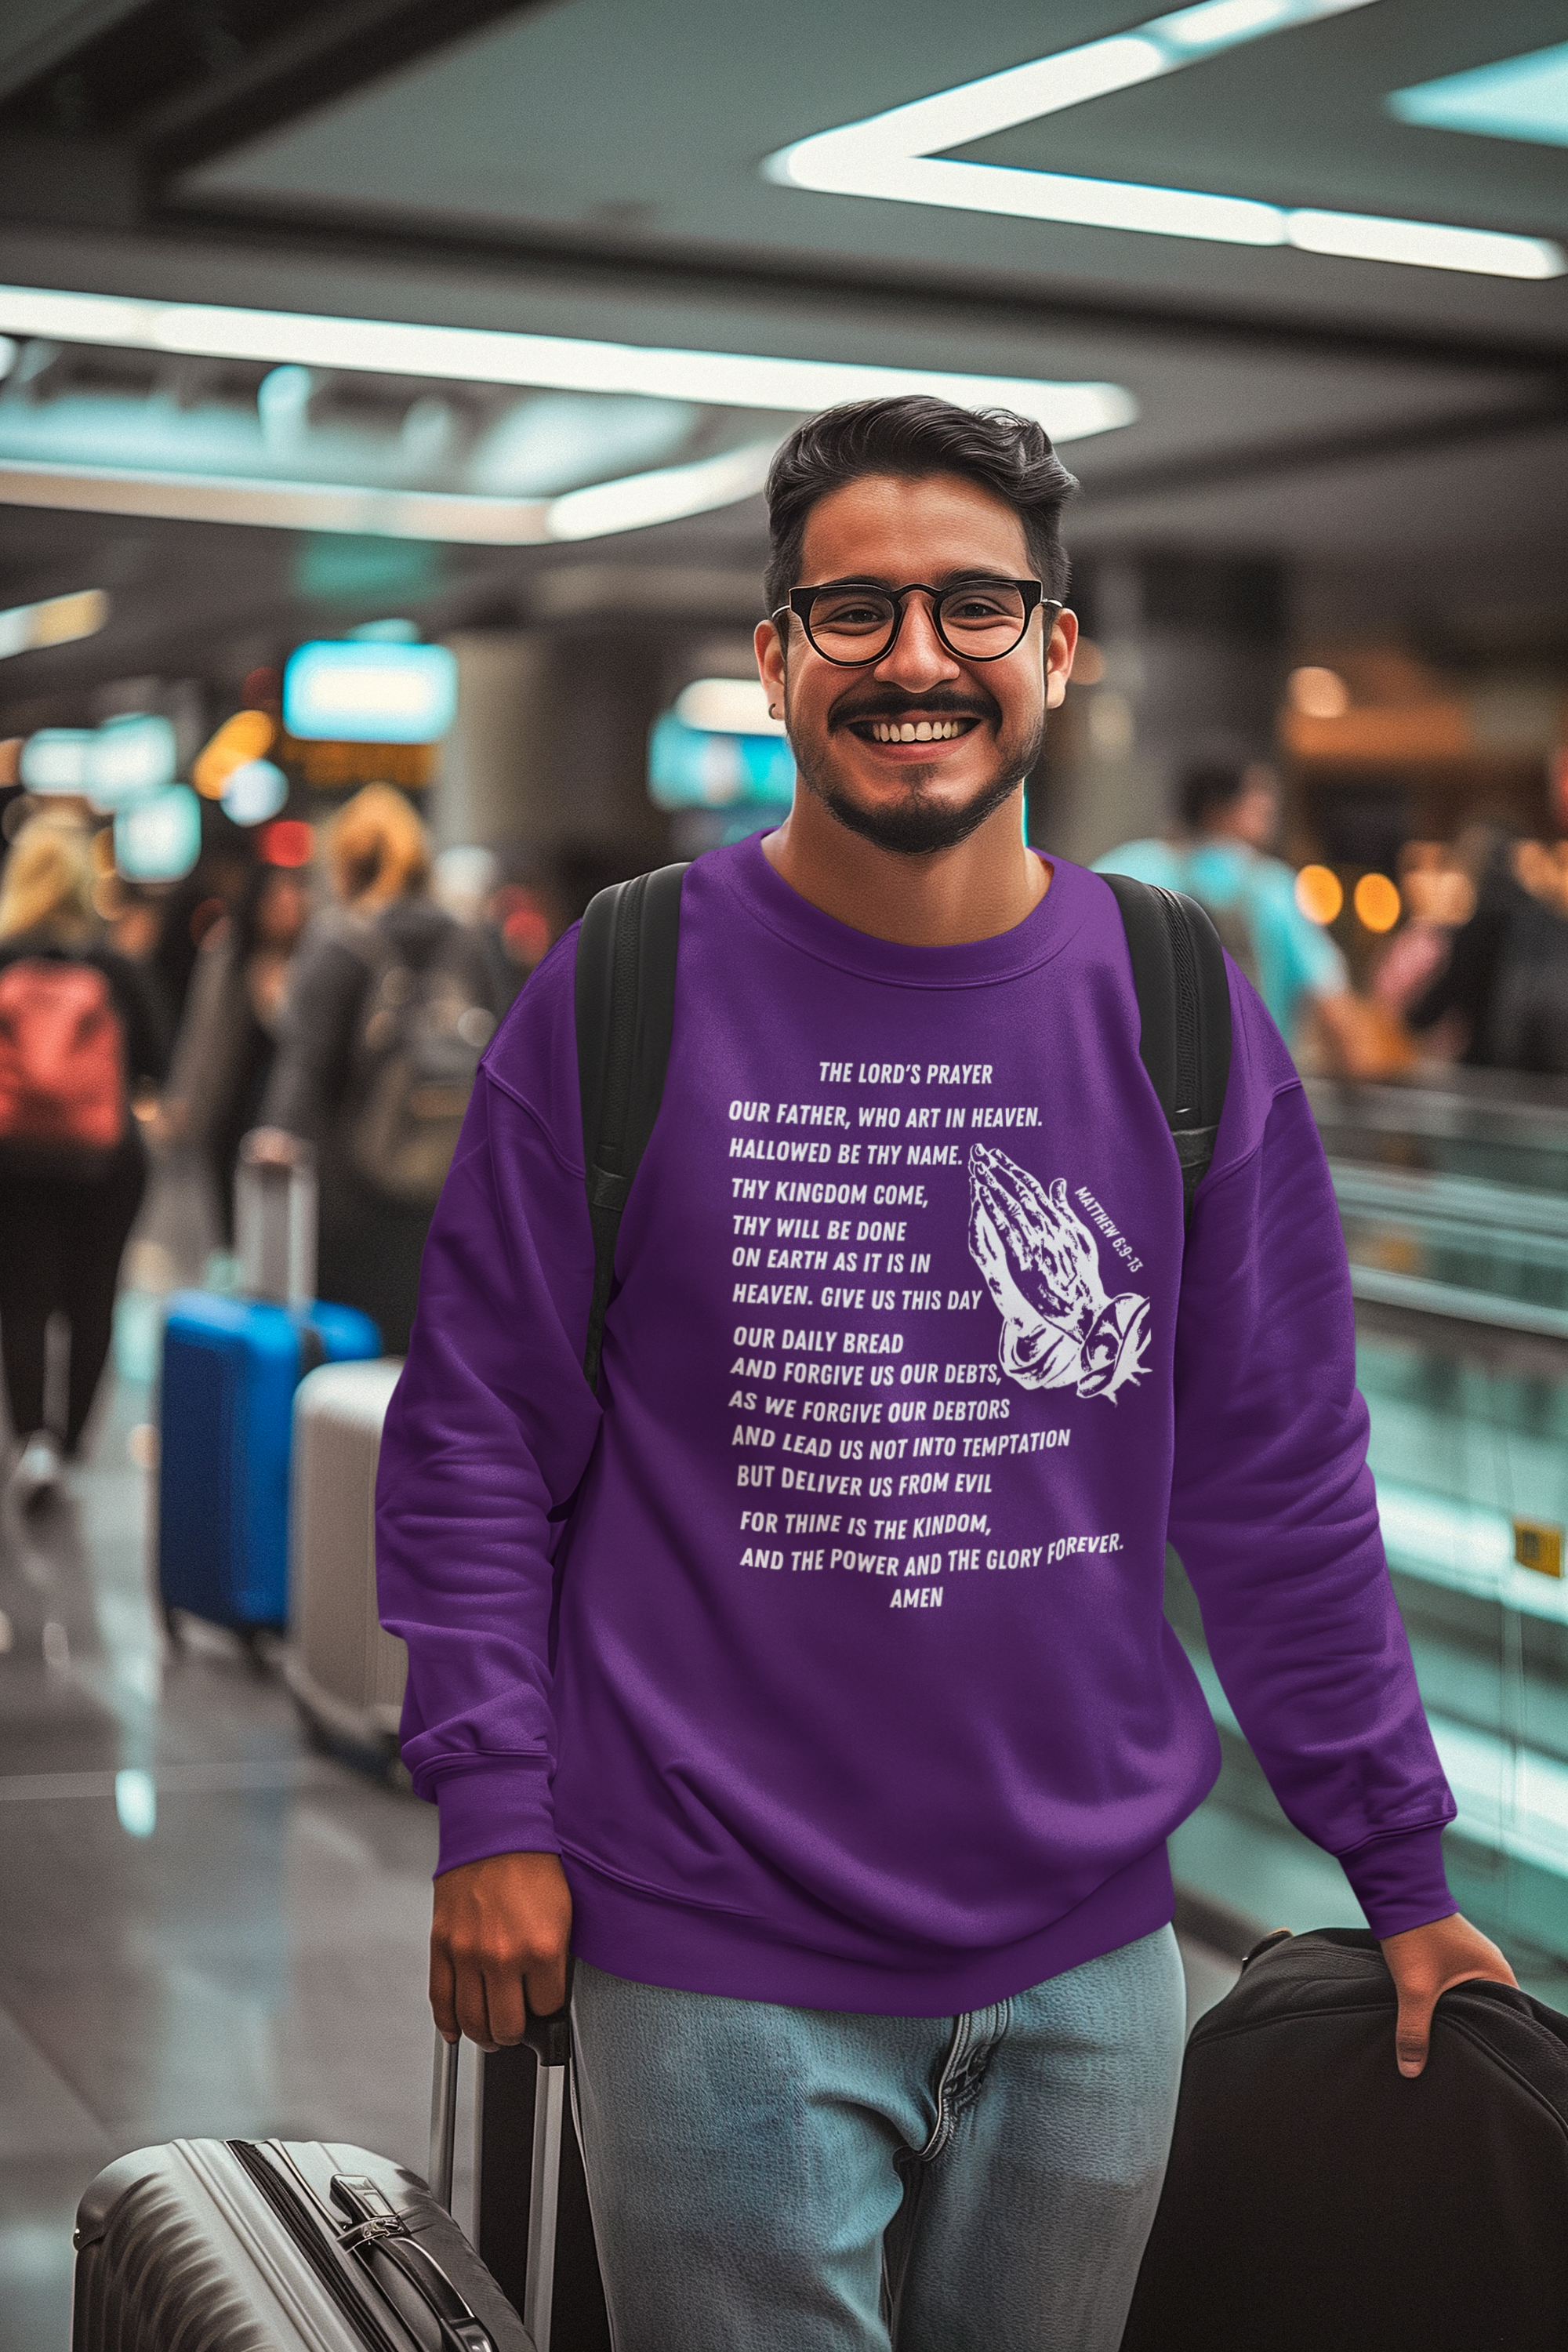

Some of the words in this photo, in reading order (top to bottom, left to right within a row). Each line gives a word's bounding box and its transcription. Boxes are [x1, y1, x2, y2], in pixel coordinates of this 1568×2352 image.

[819, 1062, 854, 1083] THE
[858, 1063, 921, 1084] LORD'S
[926, 1064, 993, 1084] PRAYER
[728, 1100, 771, 1123] OUR
[776, 1103, 851, 1130] FATHER,
[858, 1107, 901, 1128] WHO
[905, 1108, 942, 1128] ART
[945, 1108, 966, 1128] IN
[971, 1107, 1043, 1128] HEAVEN.
[728, 1138, 832, 1163] HALLOWED
[837, 1144, 862, 1164] BE
[867, 1145, 902, 1165] THY
[906, 1145, 963, 1166] NAME.
[731, 1178, 771, 1200] THY
[775, 1181, 868, 1204] KINGDOM
[873, 1185, 928, 1208] COME,
[733, 1214, 771, 1236] THY
[777, 1218, 820, 1240] WILL
[826, 1220, 852, 1240] BE
[856, 1221, 907, 1242] DONE
[1074, 1186, 1120, 1238] MATTHEW
[1112, 1236, 1143, 1272] 6:9-13
[731, 1247, 761, 1267] ON
[767, 1249, 829, 1270] EARTH
[832, 1251, 858, 1272] AS
[862, 1253, 883, 1272] IT
[887, 1253, 905, 1273] IS
[909, 1254, 931, 1273] IN
[732, 1283, 813, 1305] HEAVEN.
[821, 1287, 866, 1309] GIVE
[871, 1290, 895, 1311] US
[902, 1290, 942, 1310] THIS
[947, 1290, 983, 1310] DAY
[733, 1327, 775, 1348] OUR
[782, 1329, 838, 1352] DAILY
[842, 1332, 904, 1354] BREAD
[730, 1357, 776, 1380] AND
[783, 1362, 865, 1386] FORGIVE
[869, 1365, 895, 1386] US
[900, 1363, 938, 1385] OUR
[944, 1363, 1002, 1385] DEBTS,
[728, 1390, 757, 1410] AS
[765, 1396, 797, 1418] WE
[802, 1401, 883, 1423] FORGIVE
[887, 1401, 927, 1424] OUR
[932, 1398, 1011, 1421] DEBTORS
[732, 1425, 775, 1447] AND
[782, 1433, 832, 1457] LEAD
[839, 1439, 864, 1461] US
[869, 1438, 909, 1460] NOT
[912, 1436, 956, 1457] INTO
[963, 1428, 1071, 1457] TEMPTATION
[737, 1465, 775, 1487] BUT
[782, 1467, 862, 1496] DELIVER
[869, 1476, 893, 1497] US
[898, 1472, 949, 1496] FROM
[954, 1473, 993, 1493] EVIL
[740, 1511, 778, 1534] FOR
[785, 1514, 842, 1534] THINE
[848, 1517, 867, 1537] IS
[874, 1519, 908, 1540] THE
[913, 1513, 992, 1539] KINDOM,
[739, 1548, 784, 1570] AND
[791, 1549, 825, 1571] THE
[830, 1548, 899, 1577] POWER
[903, 1553, 942, 1577] AND
[948, 1548, 981, 1572] THE
[986, 1546, 1043, 1570] GLORY
[1047, 1533, 1123, 1565] FOREVER.
[890, 1586, 944, 1608] AMEN
